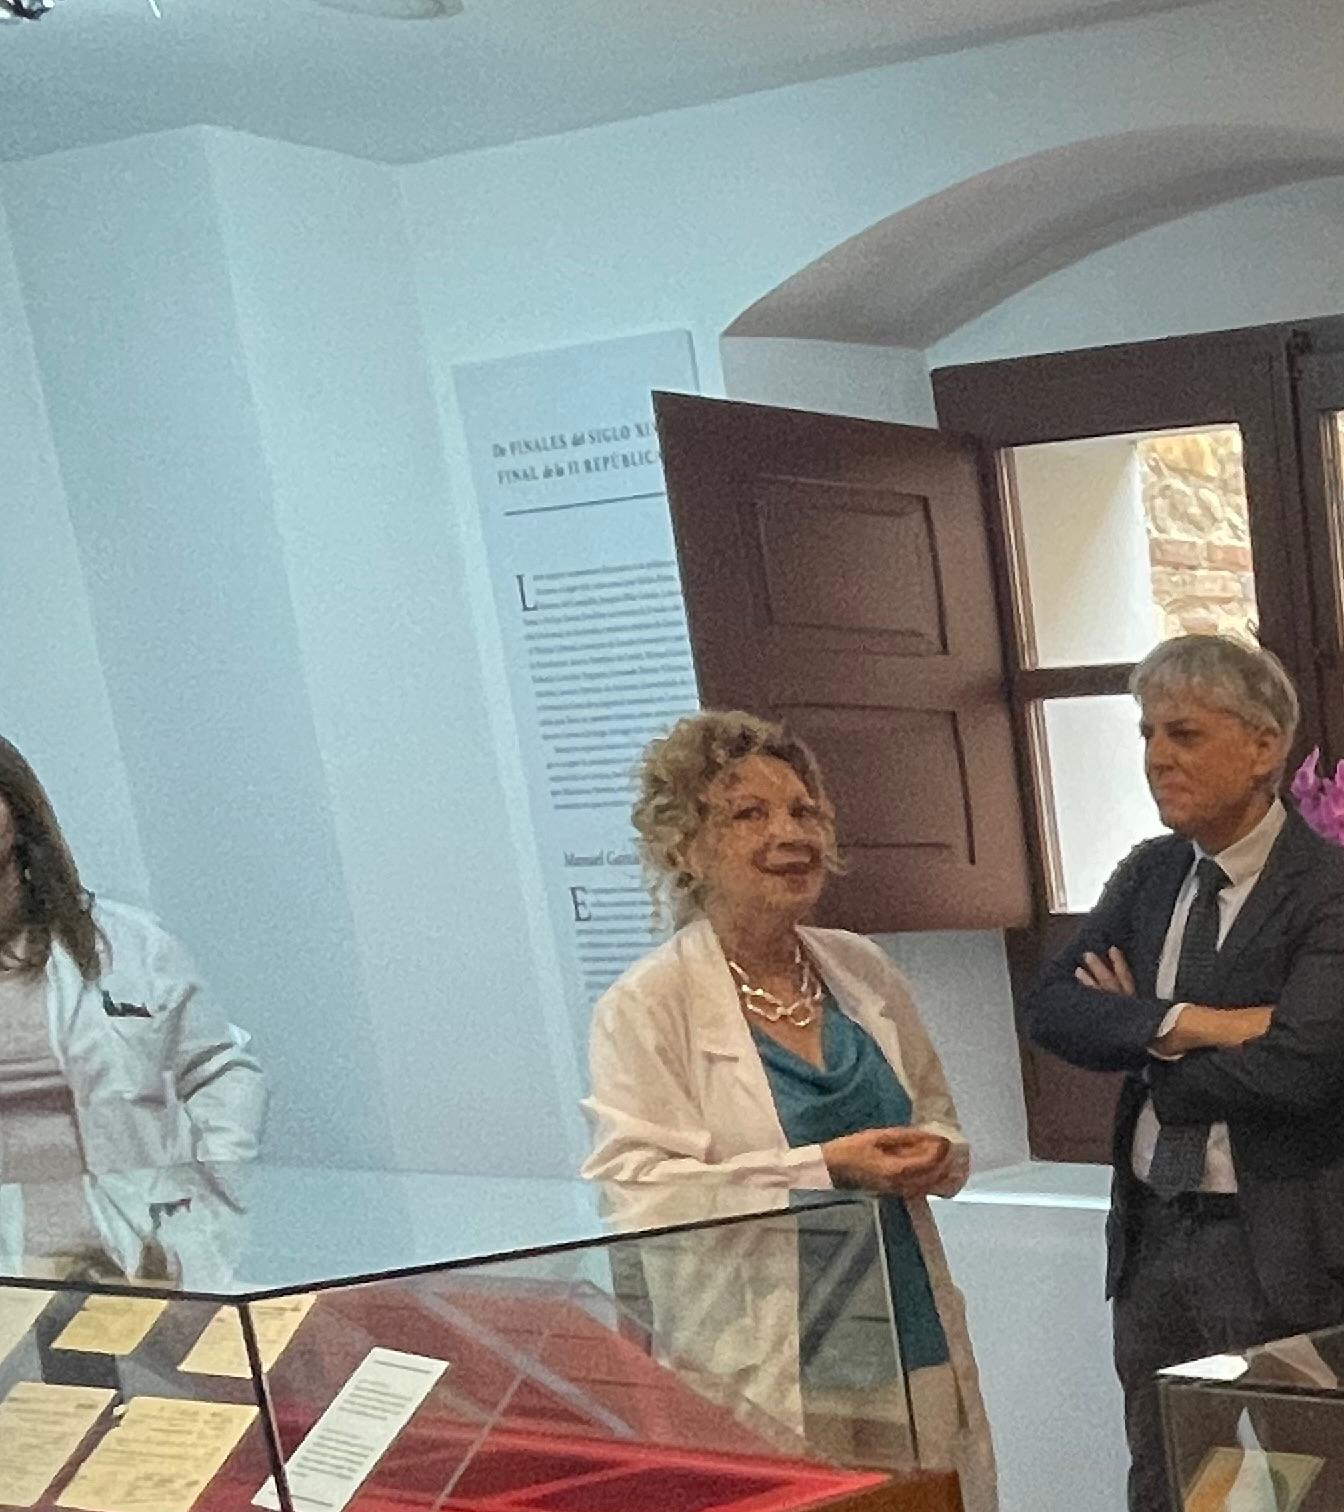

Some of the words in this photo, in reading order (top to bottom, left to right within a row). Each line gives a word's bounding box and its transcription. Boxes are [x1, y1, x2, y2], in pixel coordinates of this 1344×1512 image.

[509, 433, 567, 456] FINALES
[588, 425, 631, 444] SIGLO
[584, 450, 661, 473] REPÚBLIC
